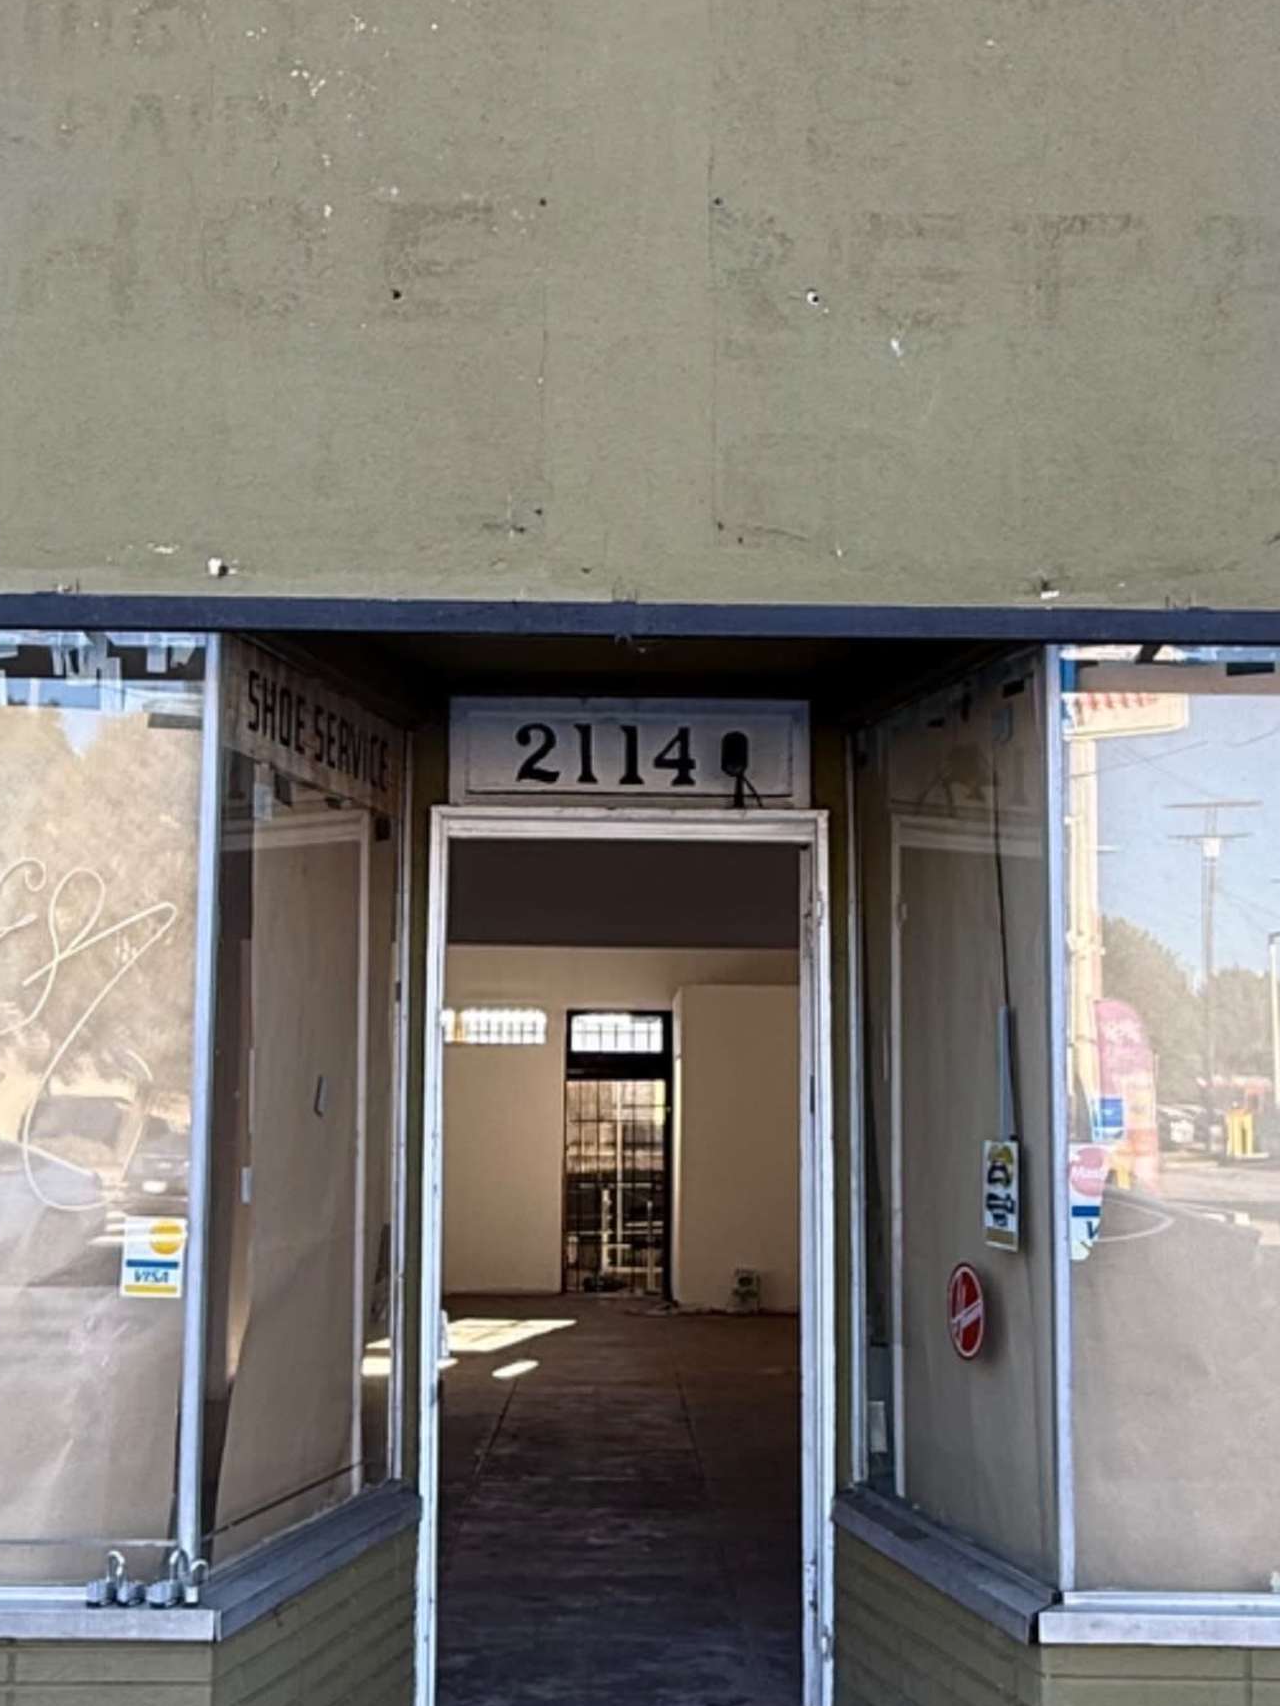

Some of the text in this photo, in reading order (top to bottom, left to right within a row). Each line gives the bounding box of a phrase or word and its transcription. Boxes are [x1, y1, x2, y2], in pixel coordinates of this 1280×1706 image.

[248, 669, 389, 792] SHOE SERVICE
[515, 722, 697, 787] 2114
